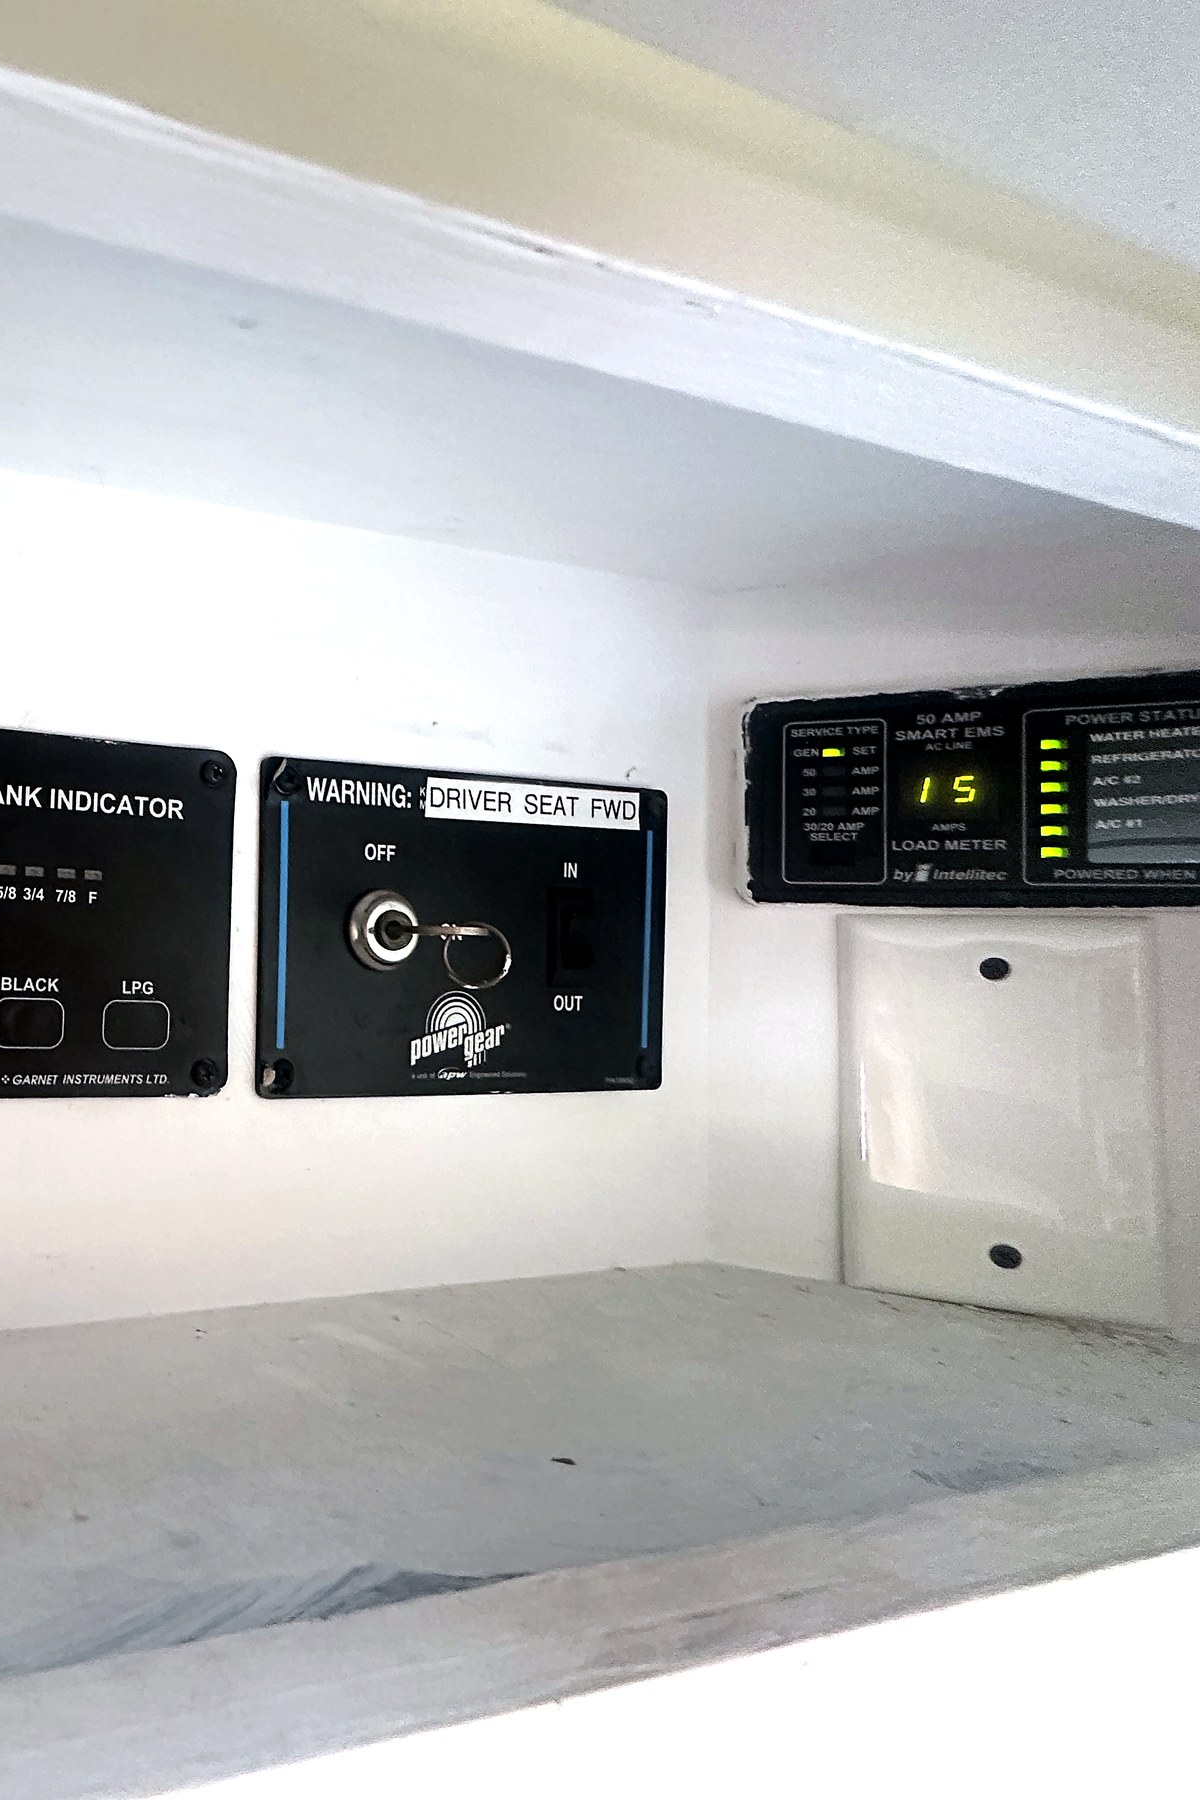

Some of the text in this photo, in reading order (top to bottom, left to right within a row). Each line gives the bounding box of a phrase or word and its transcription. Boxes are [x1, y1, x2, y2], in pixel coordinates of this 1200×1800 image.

[916, 711, 983, 725] 50 AMP
[1065, 711, 1134, 725] POWER
[790, 725, 880, 738] SERVICE TYPE
[894, 725, 1005, 741] SMART EMS
[1090, 730, 1144, 742] WATER
[793, 746, 877, 758] GEN SET
[924, 740, 975, 751] AC LINE
[851, 766, 880, 776] AMP
[305, 776, 413, 809] WARNING:
[802, 786, 880, 797] 30 AMP
[49, 787, 185, 821] INDICATOR
[429, 785, 513, 813] DRIVER
[523, 793, 580, 817] SEAT
[590, 798, 636, 821] FWD
[802, 806, 881, 817] 20 AMP
[803, 821, 866, 832] 30/20 AMP
[931, 823, 968, 832] AMPS
[810, 832, 859, 842] SELECT
[891, 839, 1007, 851] LOAD METER
[364, 843, 397, 863] OFF
[563, 862, 578, 879] IN
[893, 868, 914, 883] by
[1053, 869, 1197, 880] POWERED WHEN
[22, 887, 45, 904] 3/4
[55, 887, 77, 905] 7/8
[88, 891, 98, 905] F
[0, 975, 60, 993] BLACK
[121, 979, 155, 996] LPG
[553, 995, 583, 1013] OUT
[410, 1023, 467, 1066] power
[463, 1024, 505, 1064] gear
[12, 1073, 171, 1086] GARNET INSTRUMENTS LTD.
